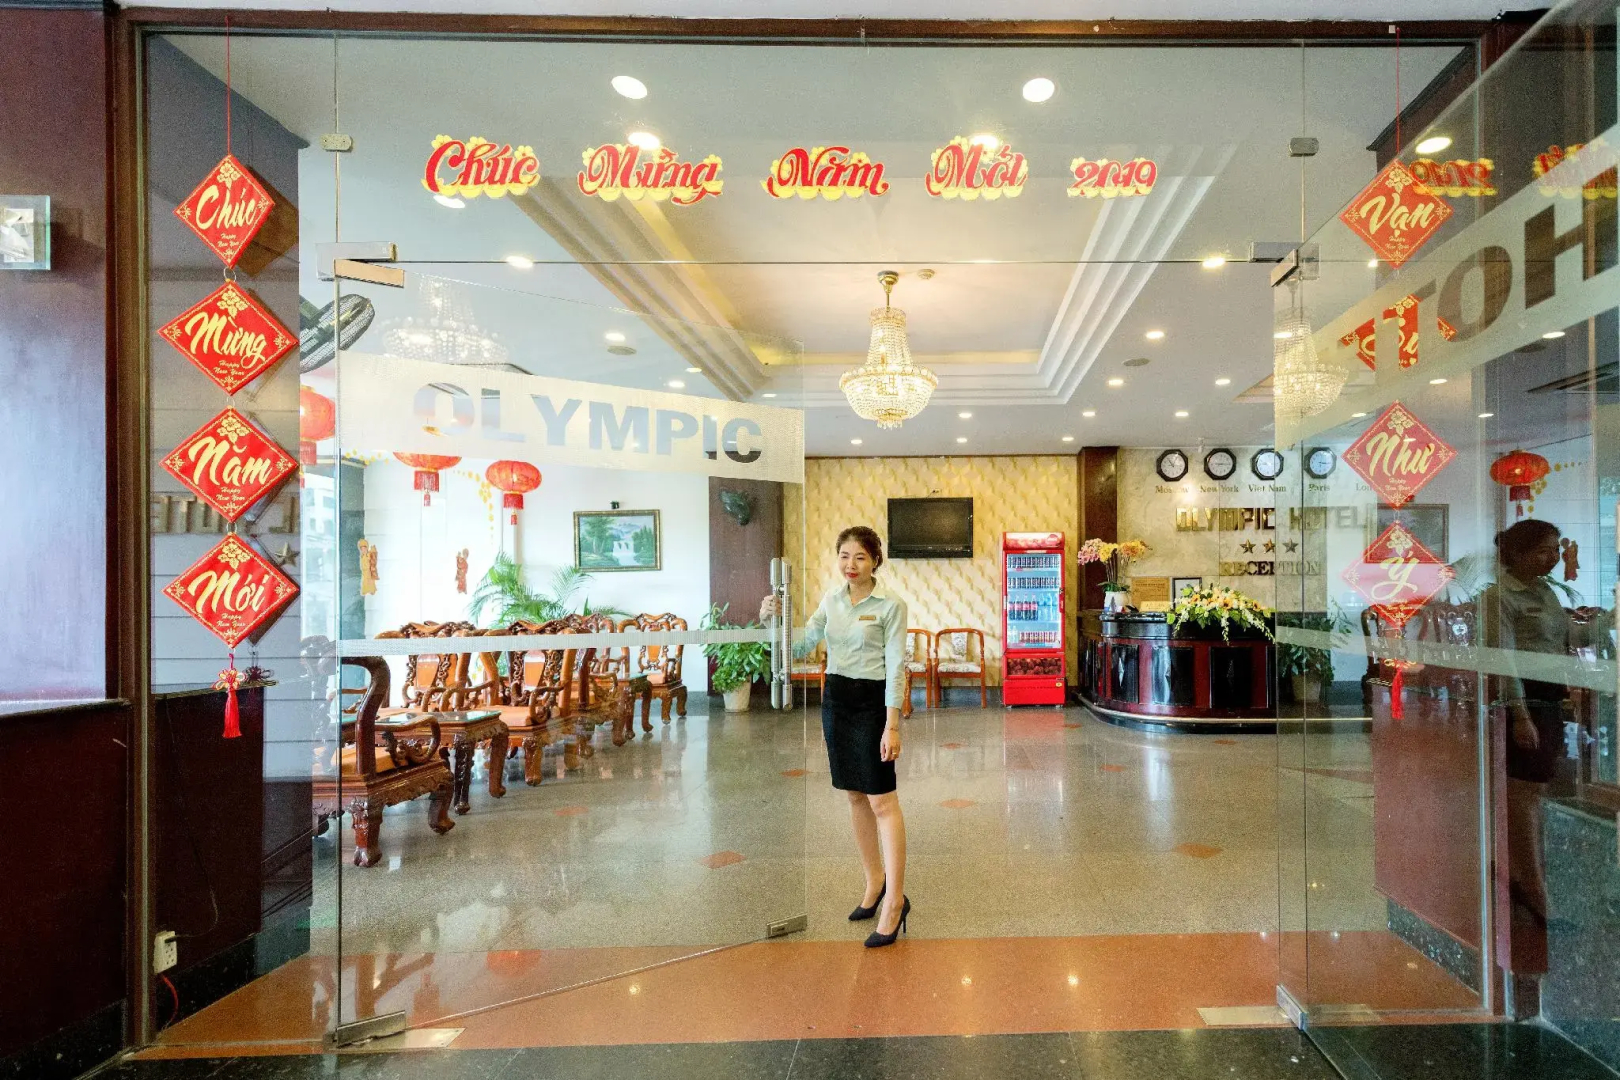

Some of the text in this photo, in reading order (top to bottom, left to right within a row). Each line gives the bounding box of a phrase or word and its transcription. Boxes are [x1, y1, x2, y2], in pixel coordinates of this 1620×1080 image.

[424, 140, 539, 193] Chúc
[767, 145, 891, 198] Năm
[1072, 159, 1158, 196] 2019
[195, 184, 257, 230] Chúc
[1359, 192, 1435, 237] Vạn
[185, 312, 267, 369] Mừng
[413, 382, 763, 464] OLYMPIC
[188, 436, 273, 486] Năm
[1365, 431, 1435, 477] Như
[1155, 484, 1190, 493] Mosw
[1200, 484, 1239, 493] New York
[1248, 483, 1265, 493] Viet
[1176, 507, 1367, 531] OLYMPIC HOTEL
[187, 570, 270, 614] Mới
